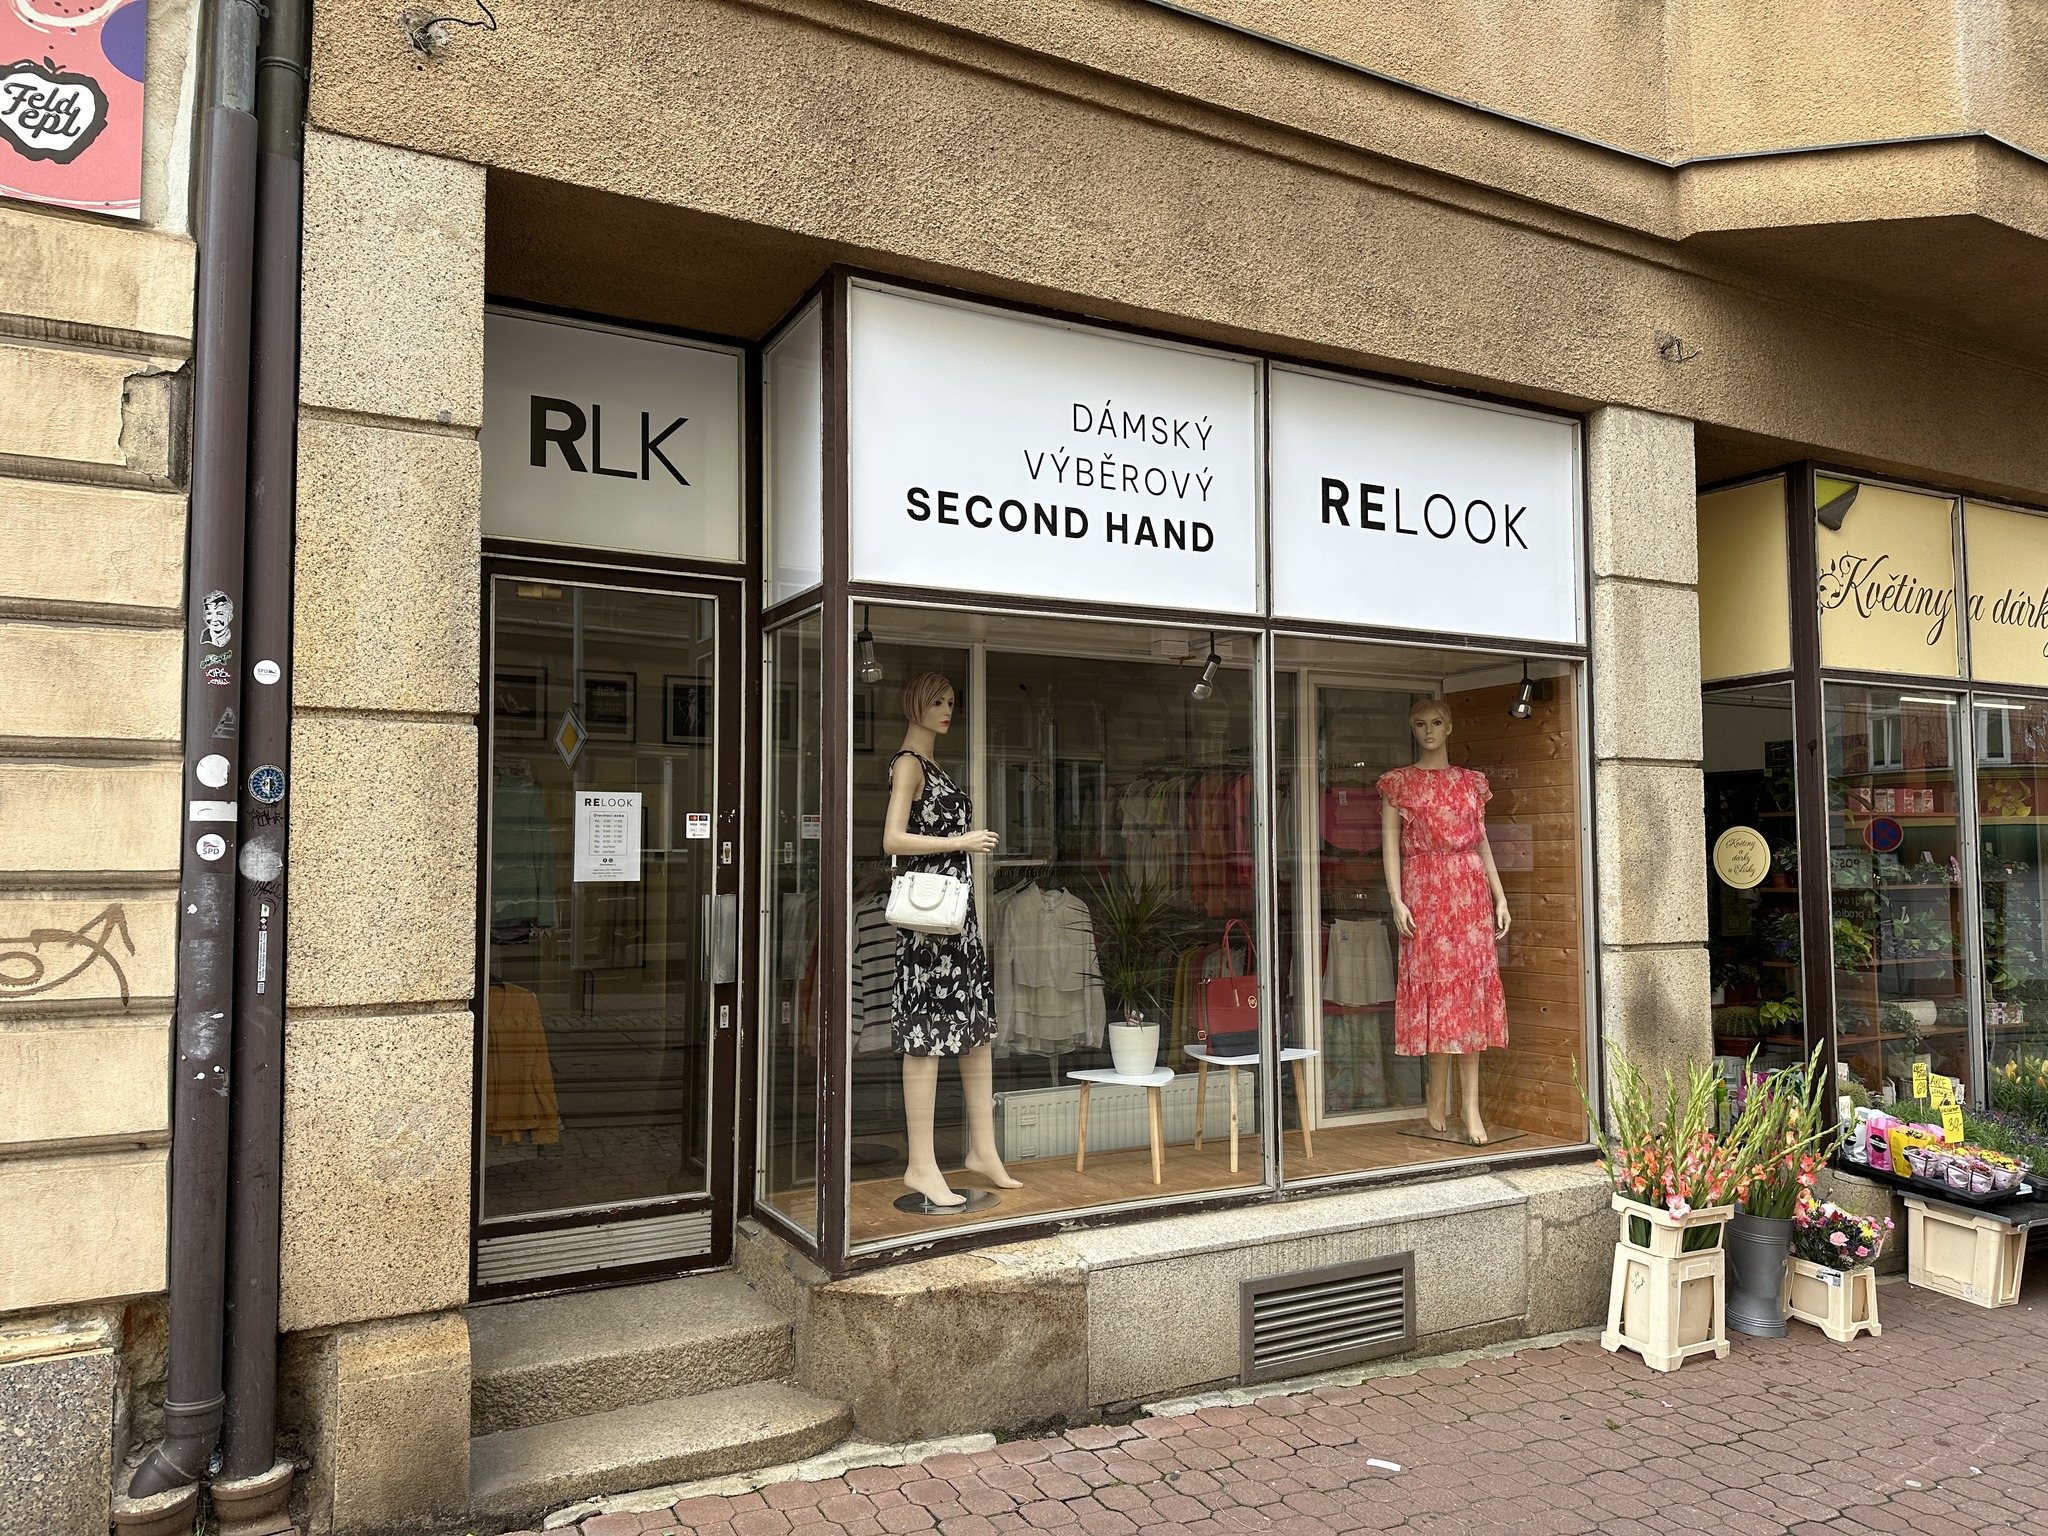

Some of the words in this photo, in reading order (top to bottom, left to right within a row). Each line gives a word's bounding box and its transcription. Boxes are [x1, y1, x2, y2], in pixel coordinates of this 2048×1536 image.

[1, 82, 80, 116] Feld
[530, 394, 691, 487] RLK
[1073, 399, 1213, 451] DÁMSKÝ
[1023, 446, 1214, 502] VÝBĚROVÝ
[906, 486, 1089, 539] SECOND
[1106, 511, 1214, 553] HAND
[1321, 476, 1528, 550] RELOOK
[1819, 551, 1953, 646] Květiny
[1969, 594, 1986, 622] a
[1992, 586, 2048, 658] dárk
[584, 798, 633, 808] RELOOK
[202, 847, 220, 855] SPD
